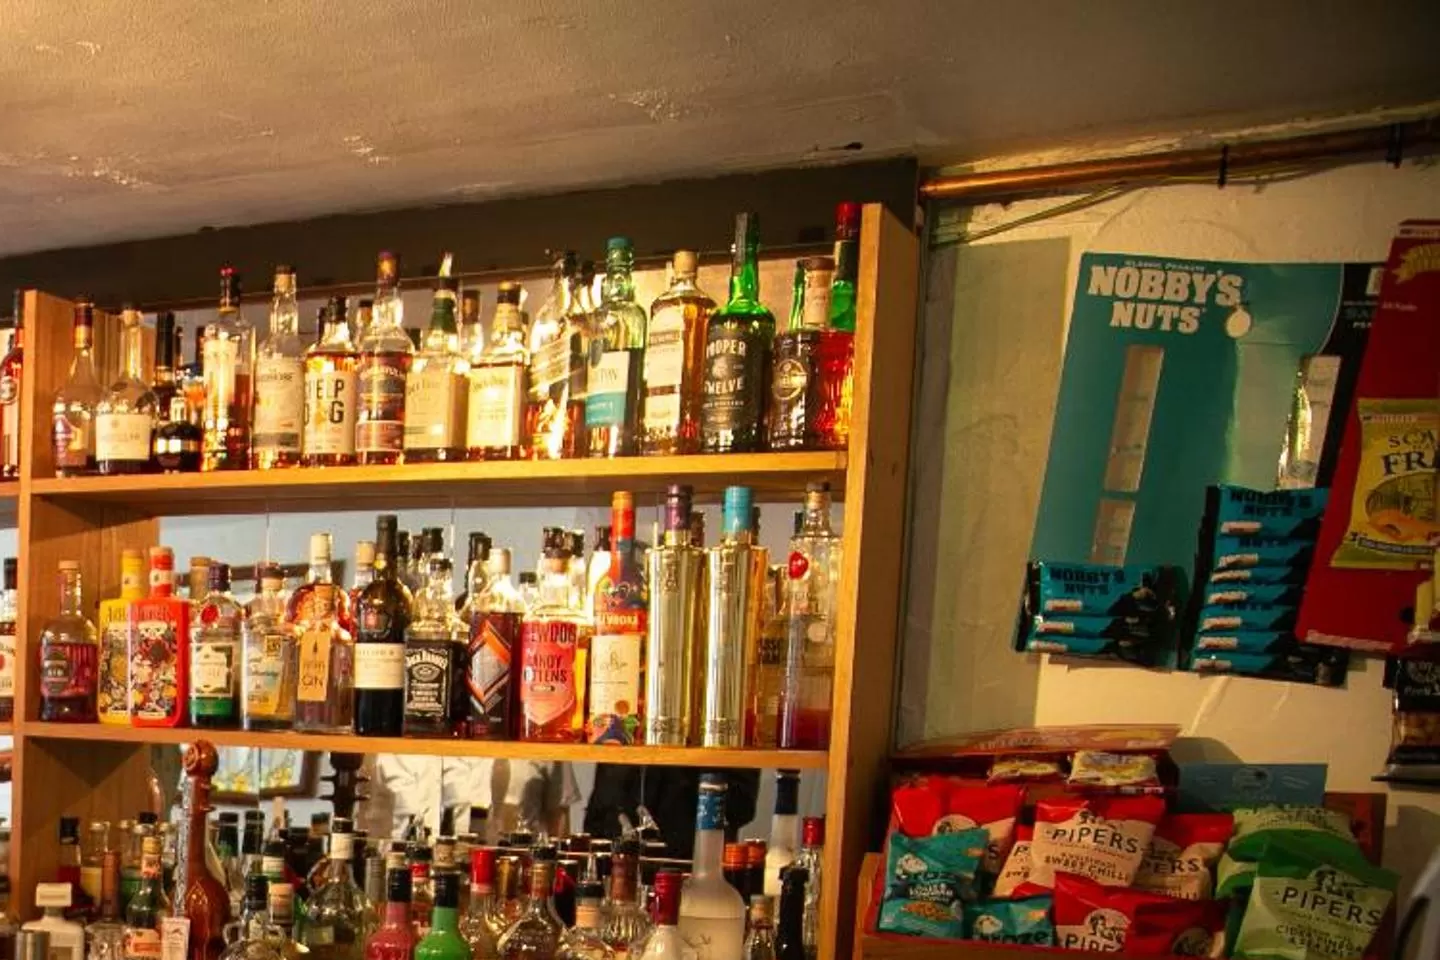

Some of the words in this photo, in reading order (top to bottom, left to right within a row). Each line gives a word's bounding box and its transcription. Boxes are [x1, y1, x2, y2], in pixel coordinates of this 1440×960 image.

[1087, 264, 1244, 306] NOBBY'S
[1110, 302, 1201, 334] NUTS
[1050, 827, 1139, 854] PIPERS
[1281, 886, 1382, 926] PIPERS
